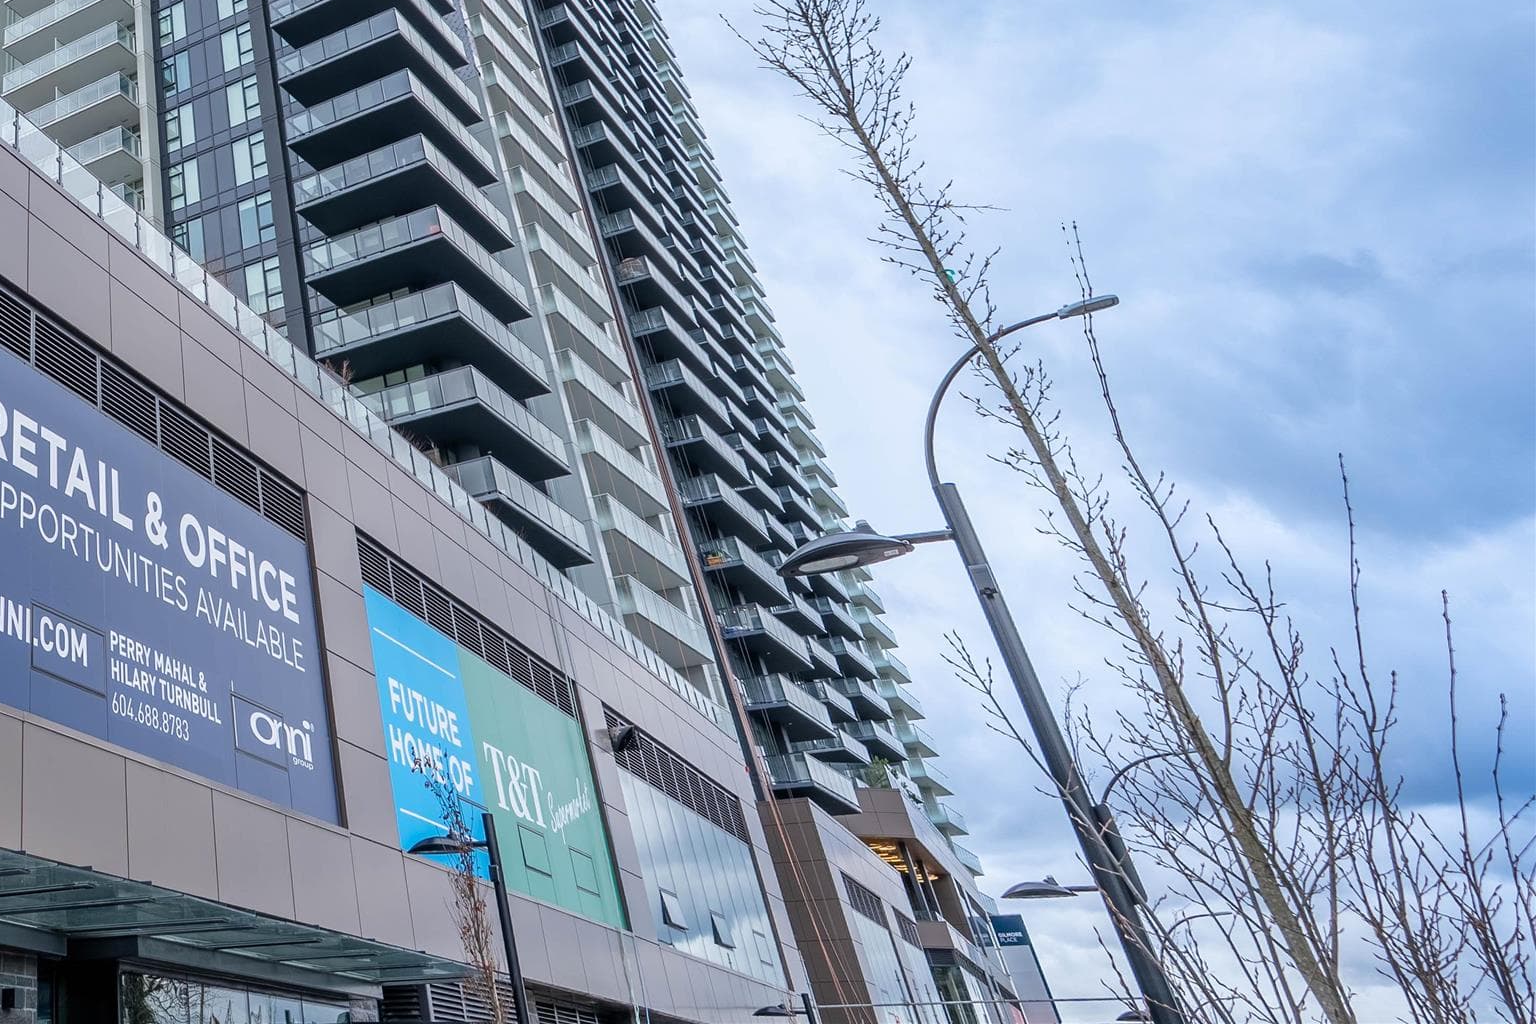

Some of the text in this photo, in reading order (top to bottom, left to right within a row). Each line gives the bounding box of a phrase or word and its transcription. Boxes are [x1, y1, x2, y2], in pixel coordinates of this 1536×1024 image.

[145, 491, 169, 550] &
[179, 513, 300, 625] OFFICE
[110, 630, 208, 694] PERRY MAHAL &
[195, 586, 306, 673] AVAILABLE
[111, 657, 222, 725] HILARY TURNBULL
[111, 691, 191, 742] 604.688.8783
[387, 676, 462, 748] FUTURE
[292, 756, 314, 770] group
[388, 723, 474, 797] HOME OF
[482, 741, 547, 829] T&T
